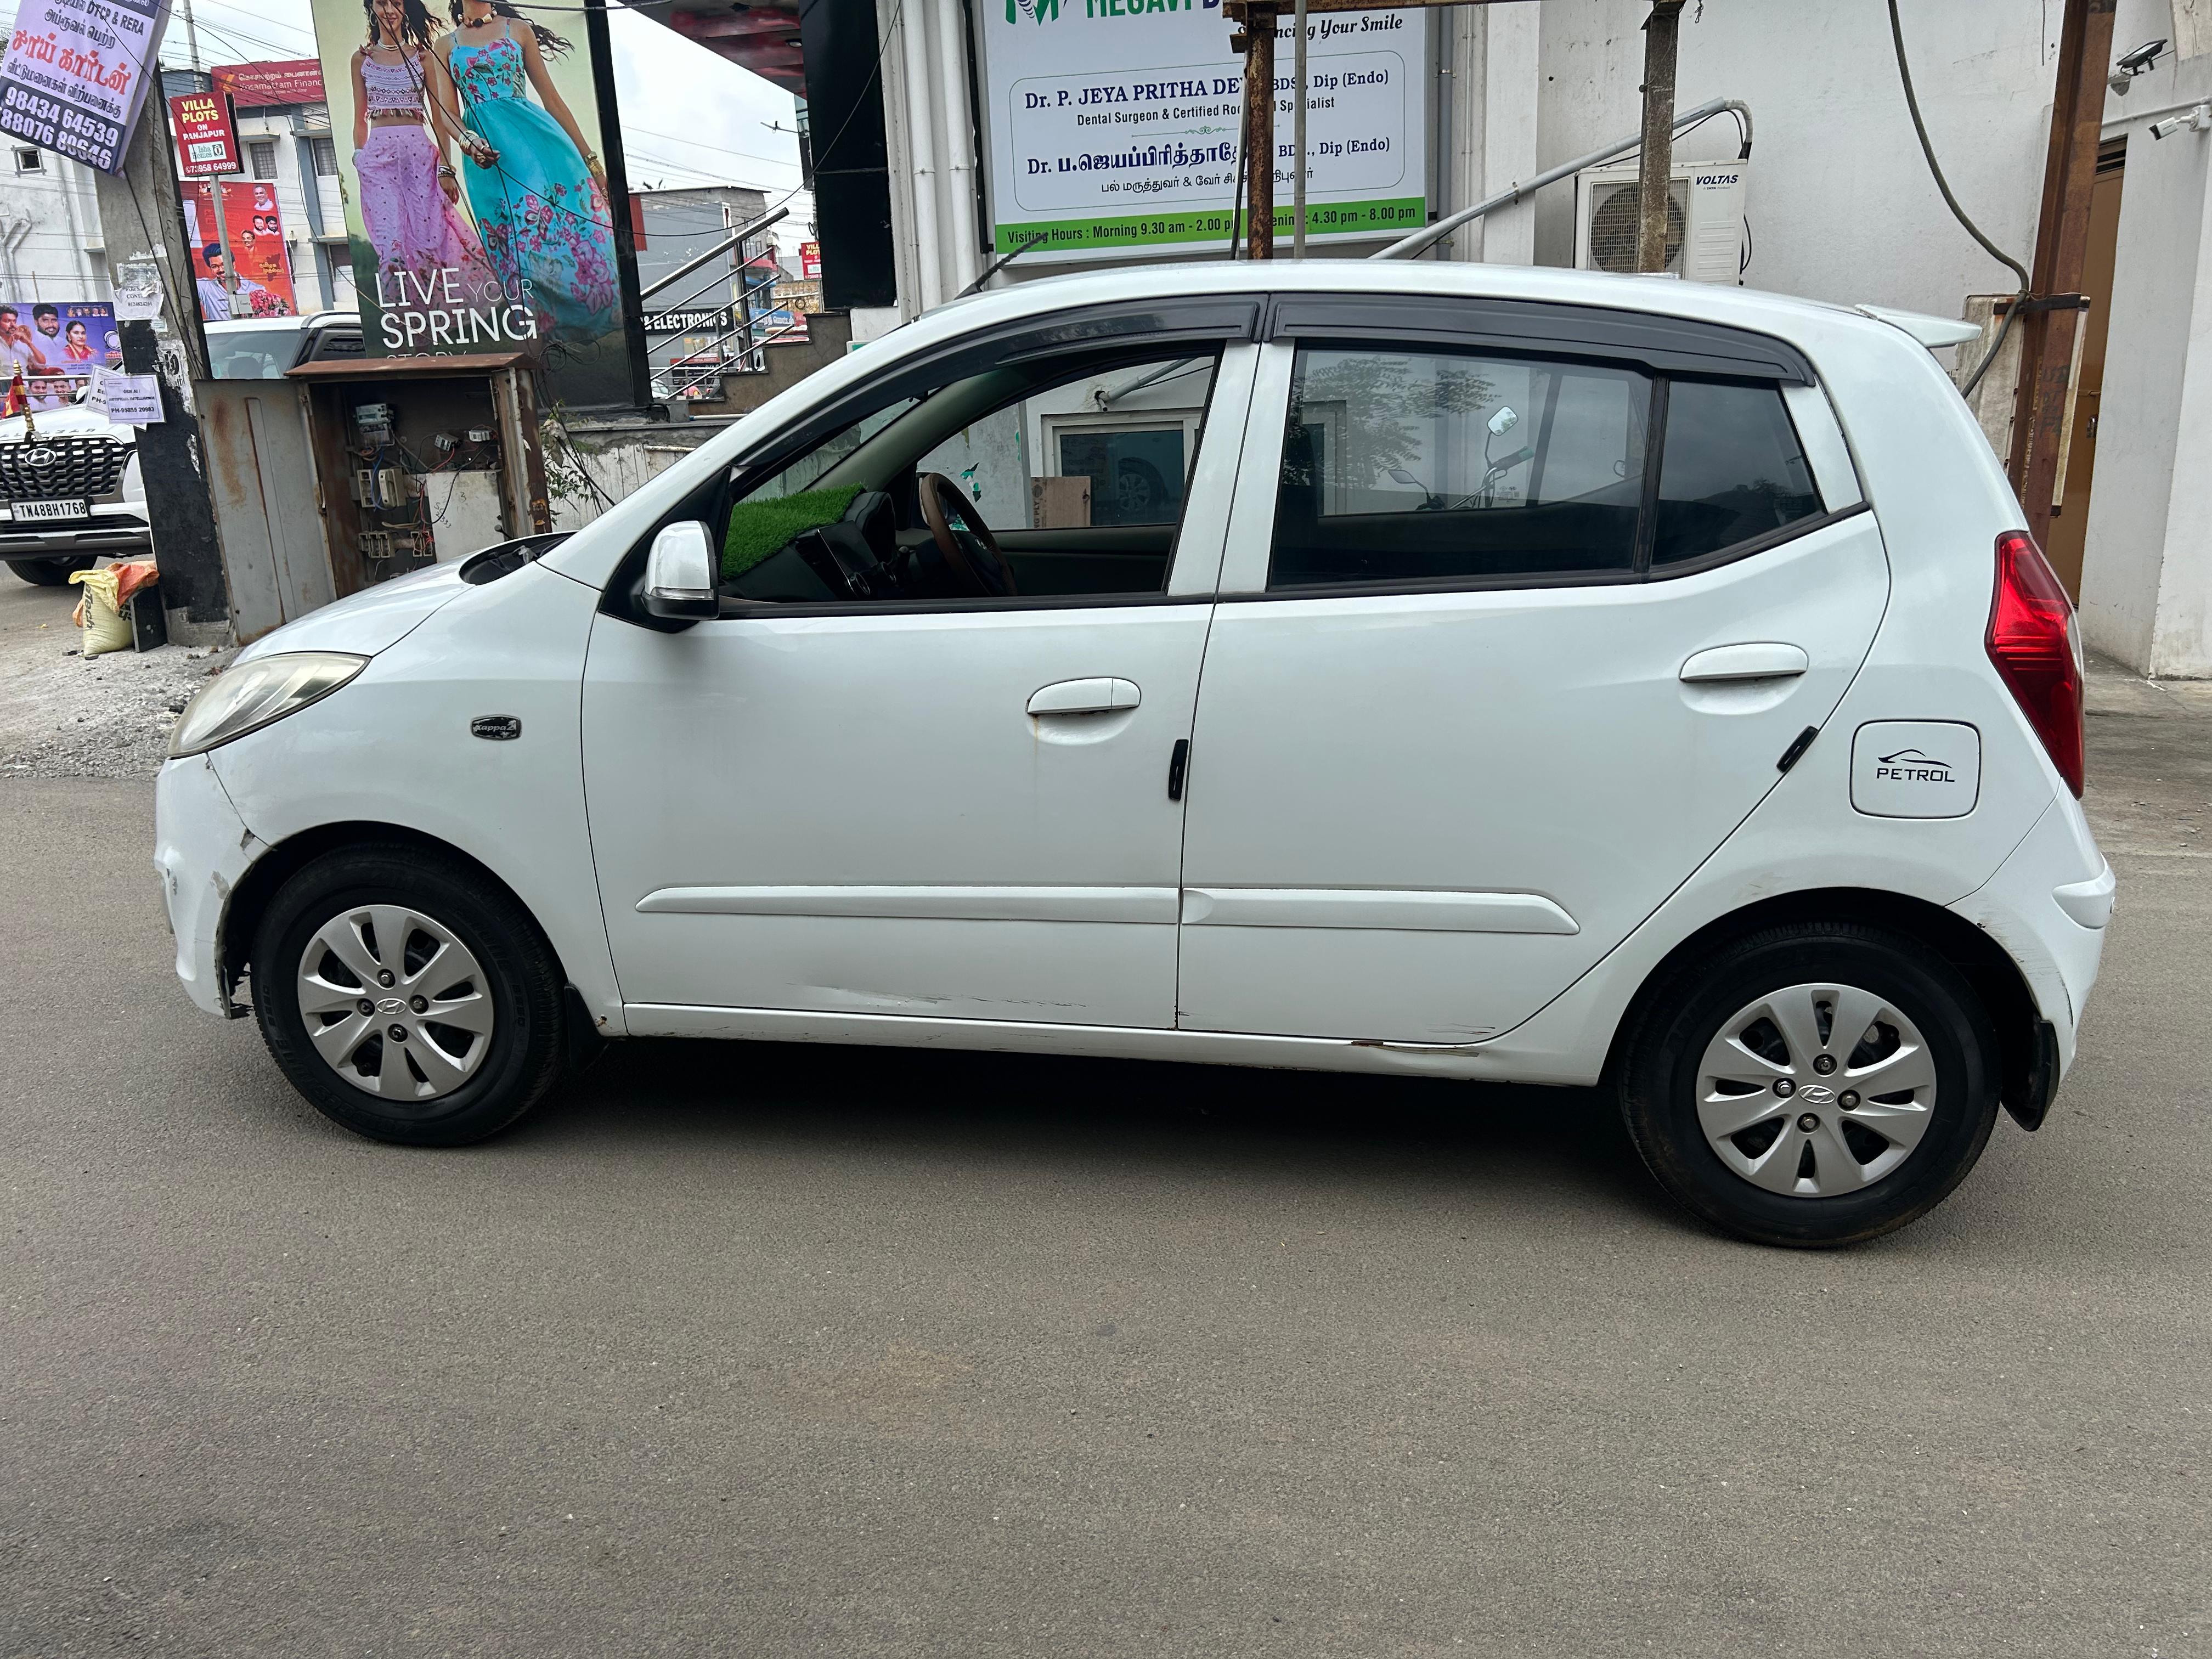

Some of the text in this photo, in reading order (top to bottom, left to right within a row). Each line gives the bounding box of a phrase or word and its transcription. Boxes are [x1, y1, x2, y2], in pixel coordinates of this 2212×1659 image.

[86, 1, 111, 20] DTCP
[111, 12, 119, 25] &
[120, 15, 144, 36] RERA
[1321, 19, 1357, 39] Your
[1361, 14, 1403, 32] Smile
[12, 30, 132, 95] சாய் கார்டன்
[1025, 93, 1051, 109] Dr.
[1057, 90, 1072, 106] P.
[1079, 86, 1128, 105] JEYA
[1133, 80, 1207, 101] PRITHA
[1313, 74, 1338, 89] Dip
[1342, 69, 1389, 88] (Endo)
[5, 86, 119, 148] 98434 64539
[181, 98, 215, 112] VILLA
[182, 109, 219, 124] PLOTS
[1077, 114, 1111, 126] Dental
[1115, 110, 1159, 124] Surgeon
[1163, 108, 1170, 120] &
[1173, 104, 1219, 119] Certified
[1280, 97, 1335, 114] Spialist
[0, 108, 55, 145] 88076
[183, 129, 225, 141] PANJAPUR
[198, 145, 211, 153] Isha
[1028, 157, 1052, 174] Dr.
[1319, 141, 1342, 156] Dip
[1347, 137, 1390, 155] (Endo)
[213, 161, 236, 171] 64999
[1102, 179, 1120, 193] பல்
[1123, 176, 1180, 193] மருத்துவர்
[1183, 177, 1192, 187] &
[1195, 173, 1221, 185] வேர்
[1696, 174, 1739, 185] VOLTAS
[1052, 228, 1082, 240] Hours
[1093, 224, 1137, 239] Morning
[1141, 222, 1165, 235] 9.30
[1169, 223, 1186, 233] am
[1196, 218, 1221, 232] 2.00
[1312, 211, 1337, 224] 4.30
[1341, 213, 1358, 225] pm
[1369, 207, 1395, 221] 8.00
[1398, 206, 1415, 221] pm
[375, 268, 534, 308] LIVE YOUR
[380, 304, 538, 349] SPRING
[653, 311, 727, 330] ELECTRONIS
[19, 503, 87, 518] TN48BH1768
[1876, 768, 1955, 782] PETROL
